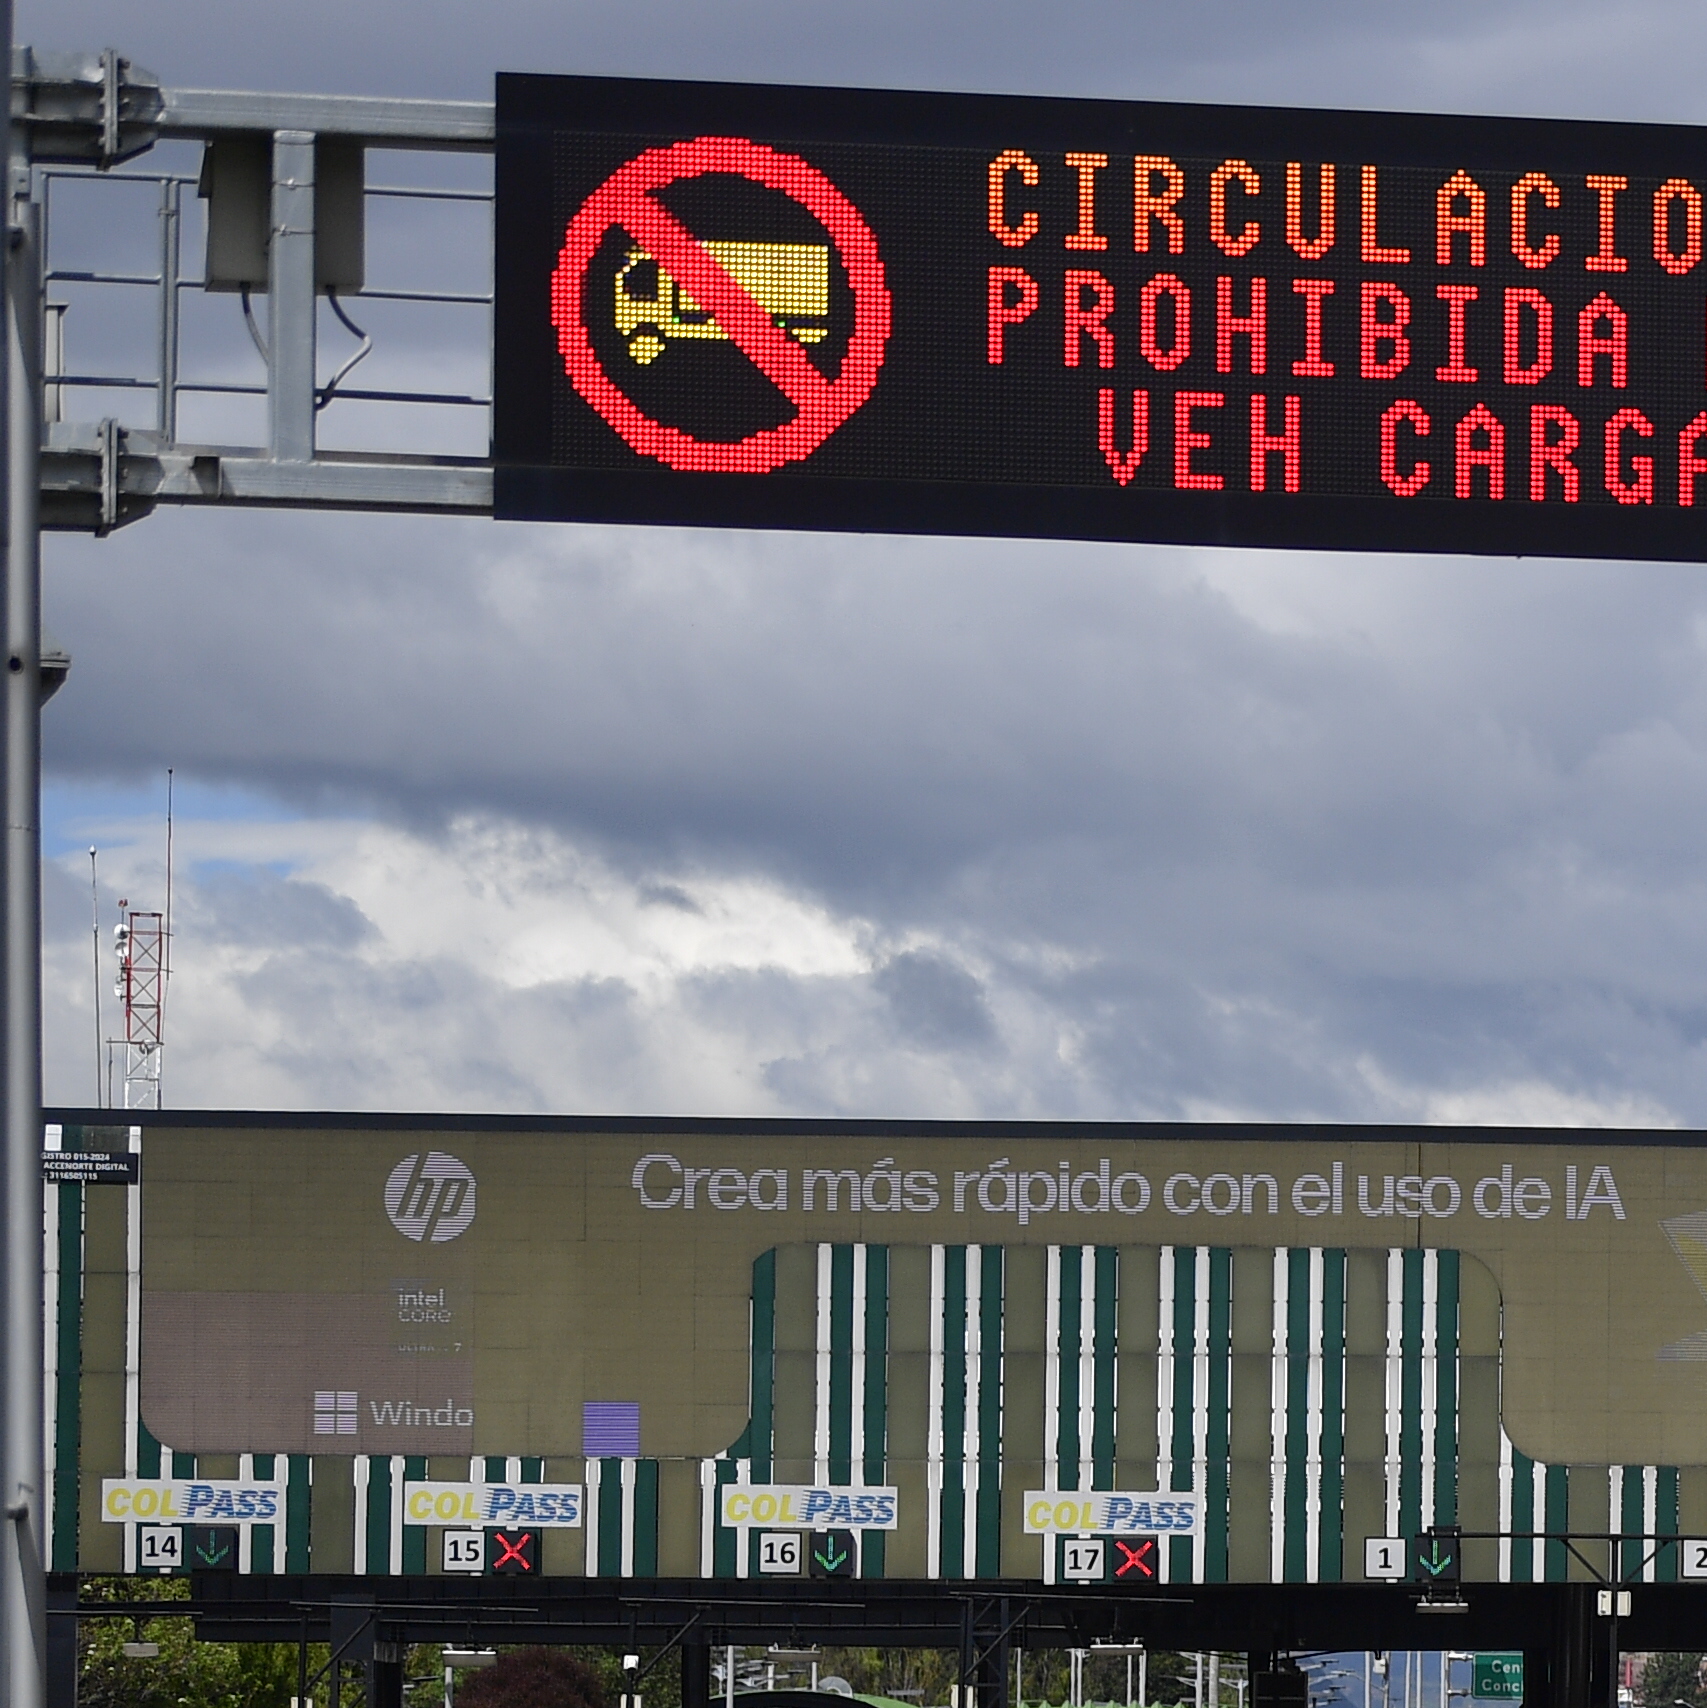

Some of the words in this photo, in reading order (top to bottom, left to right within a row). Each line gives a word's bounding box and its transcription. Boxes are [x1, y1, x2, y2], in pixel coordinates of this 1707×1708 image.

[987, 268, 1629, 390] PROHIBIDA
[1098, 388, 1303, 494] VEH
[41, 1152, 72, 1160] GISTRO
[95, 1163, 130, 1171] DIGITAL
[631, 1153, 788, 1212] Crea
[802, 1157, 939, 1213] más
[954, 1157, 1151, 1226] rápido
[1162, 1170, 1277, 1217] con
[1291, 1161, 1344, 1217] el
[1357, 1173, 1462, 1220] uso
[1473, 1164, 1552, 1220] de
[1565, 1165, 1626, 1221] IA
[399, 1288, 444, 1306] intel
[143, 1533, 178, 1561] 14
[448, 1536, 481, 1564] 15
[763, 1540, 797, 1566] 16
[1067, 1546, 1101, 1572] 17
[1376, 1546, 1393, 1570] 1
[1491, 1661, 1523, 1674] Cen
[1482, 1679, 1523, 1692] Conc
